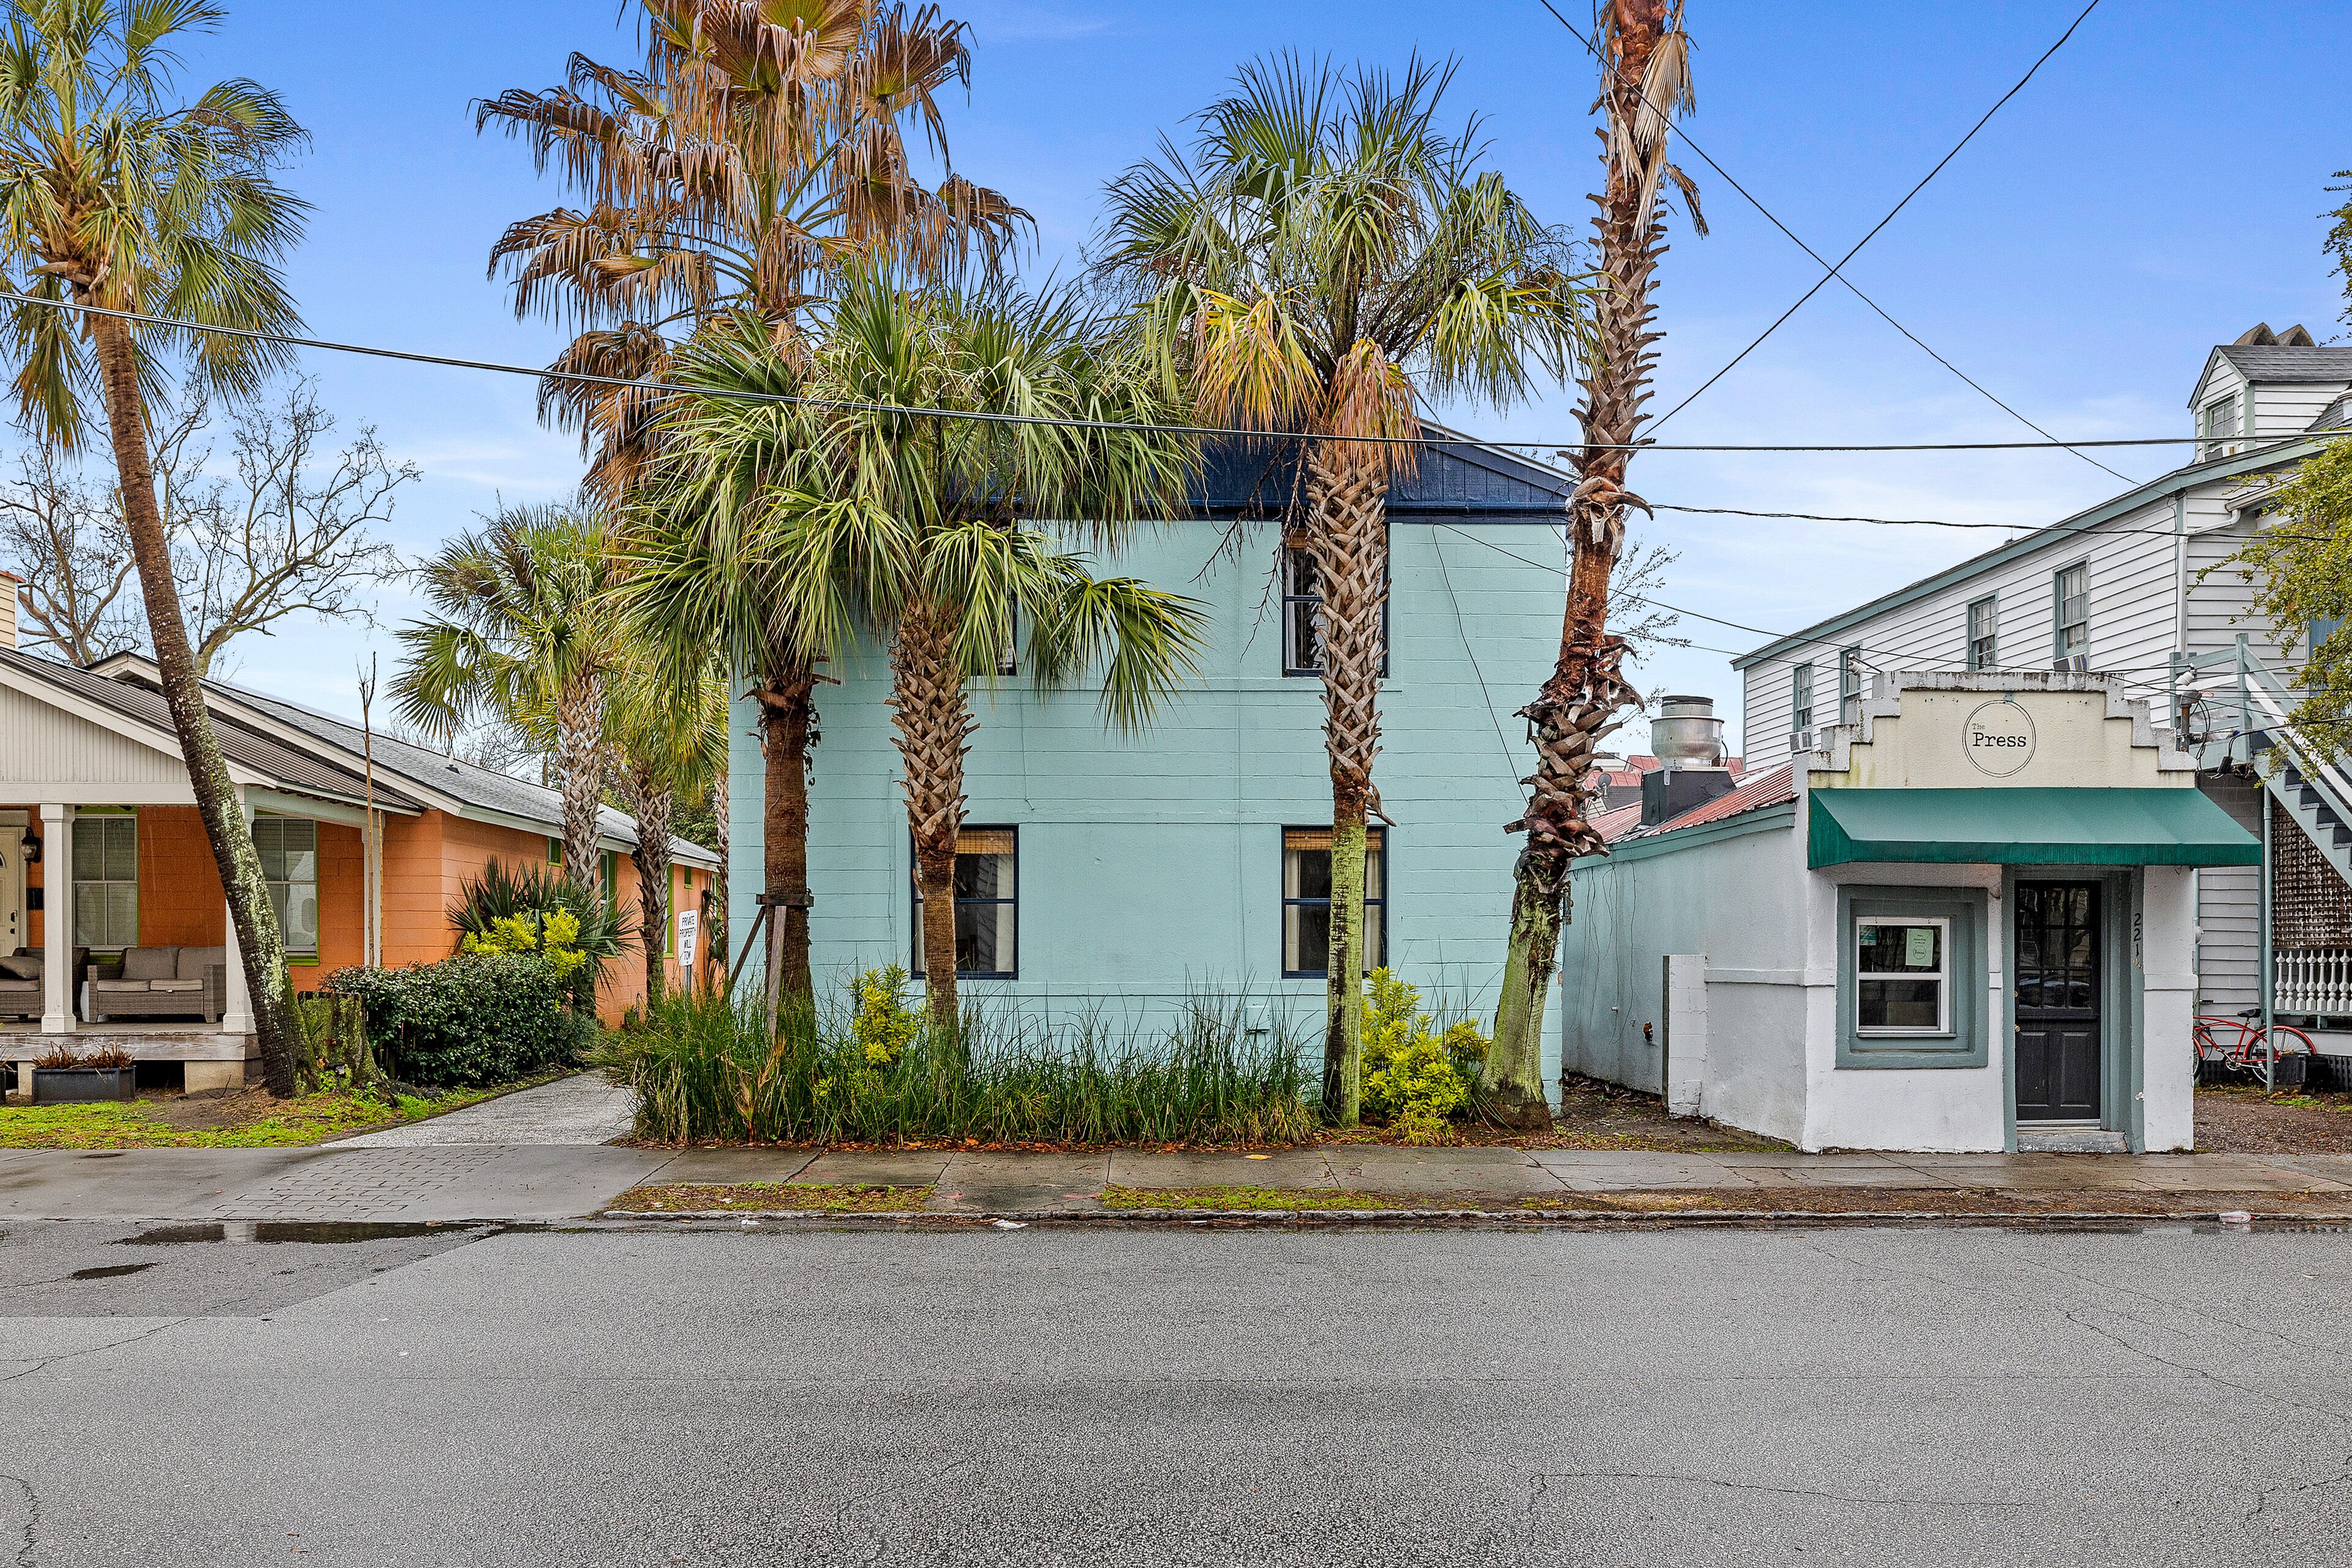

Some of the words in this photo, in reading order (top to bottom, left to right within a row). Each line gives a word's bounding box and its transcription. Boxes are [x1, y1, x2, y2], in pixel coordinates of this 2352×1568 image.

[1972, 733, 2026, 747] Press
[682, 916, 695, 926] PRIVATE
[679, 927, 696, 938] PROPERTY
